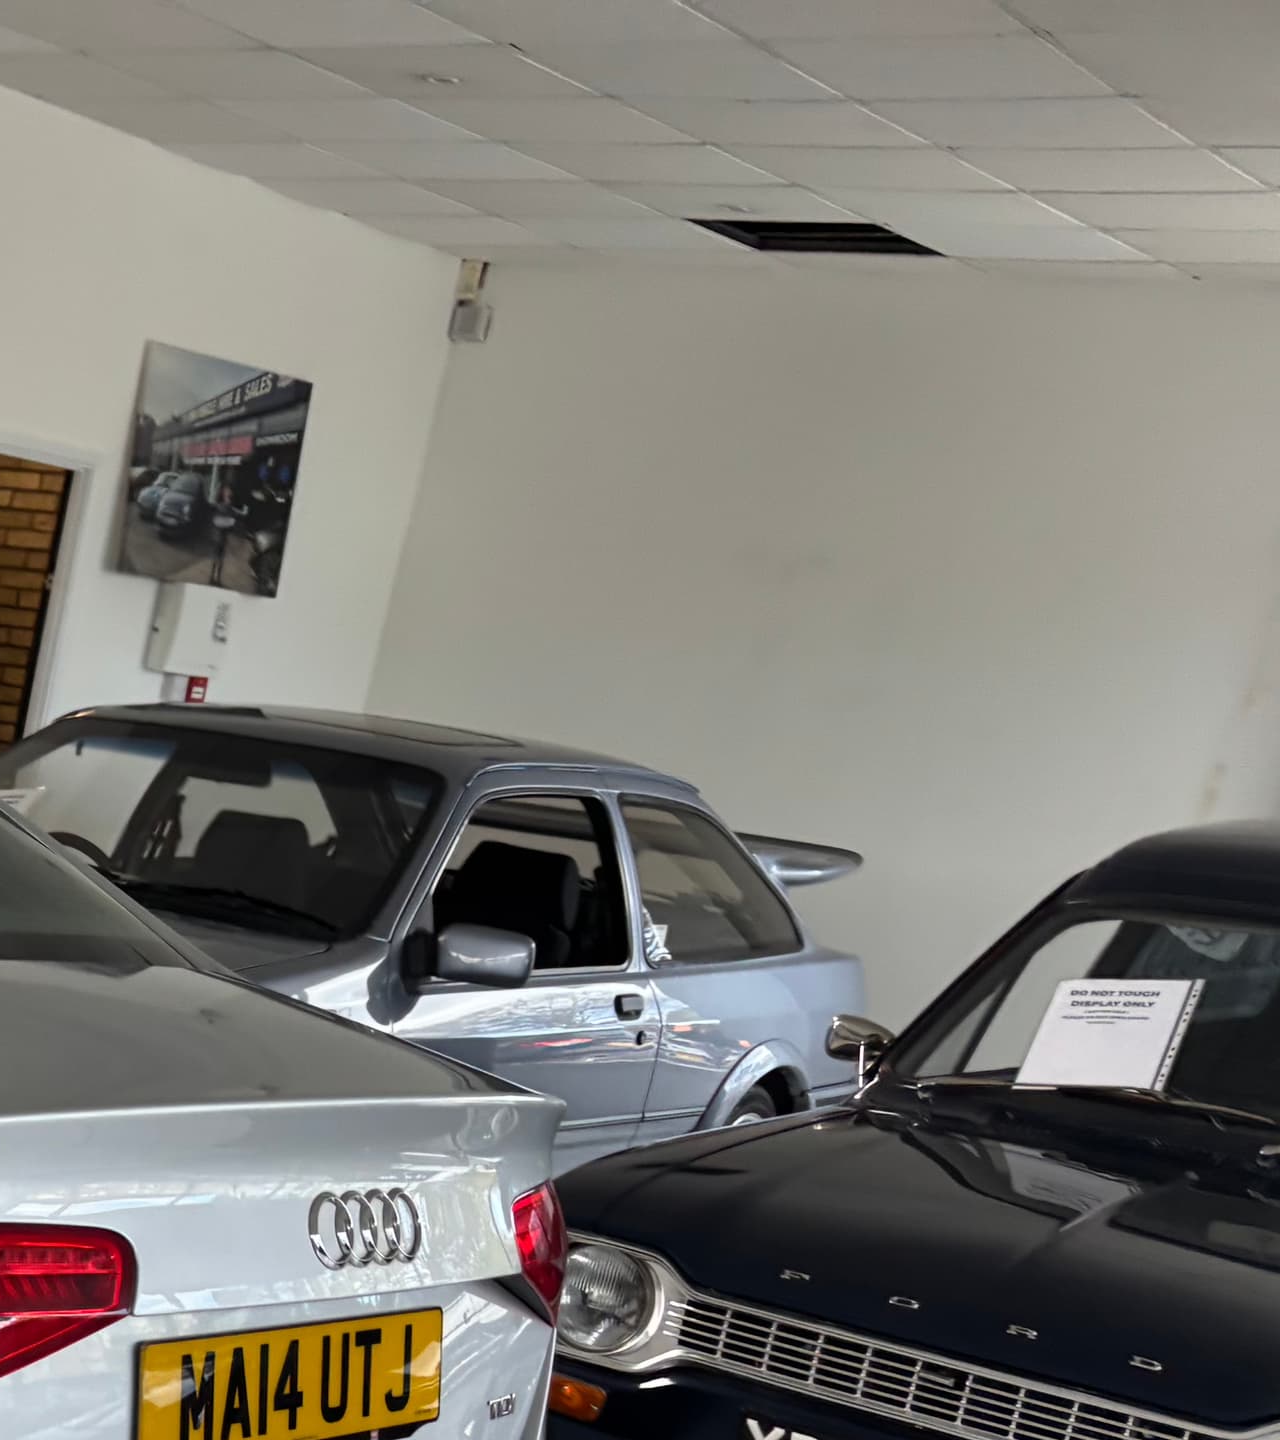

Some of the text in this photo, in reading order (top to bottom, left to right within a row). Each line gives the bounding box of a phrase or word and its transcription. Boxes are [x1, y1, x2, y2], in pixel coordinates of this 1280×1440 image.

[1070, 989, 1161, 998] DO NOT TOUCH
[1122, 1000, 1156, 1008] ONLY
[319, 1324, 413, 1424] UTJ
